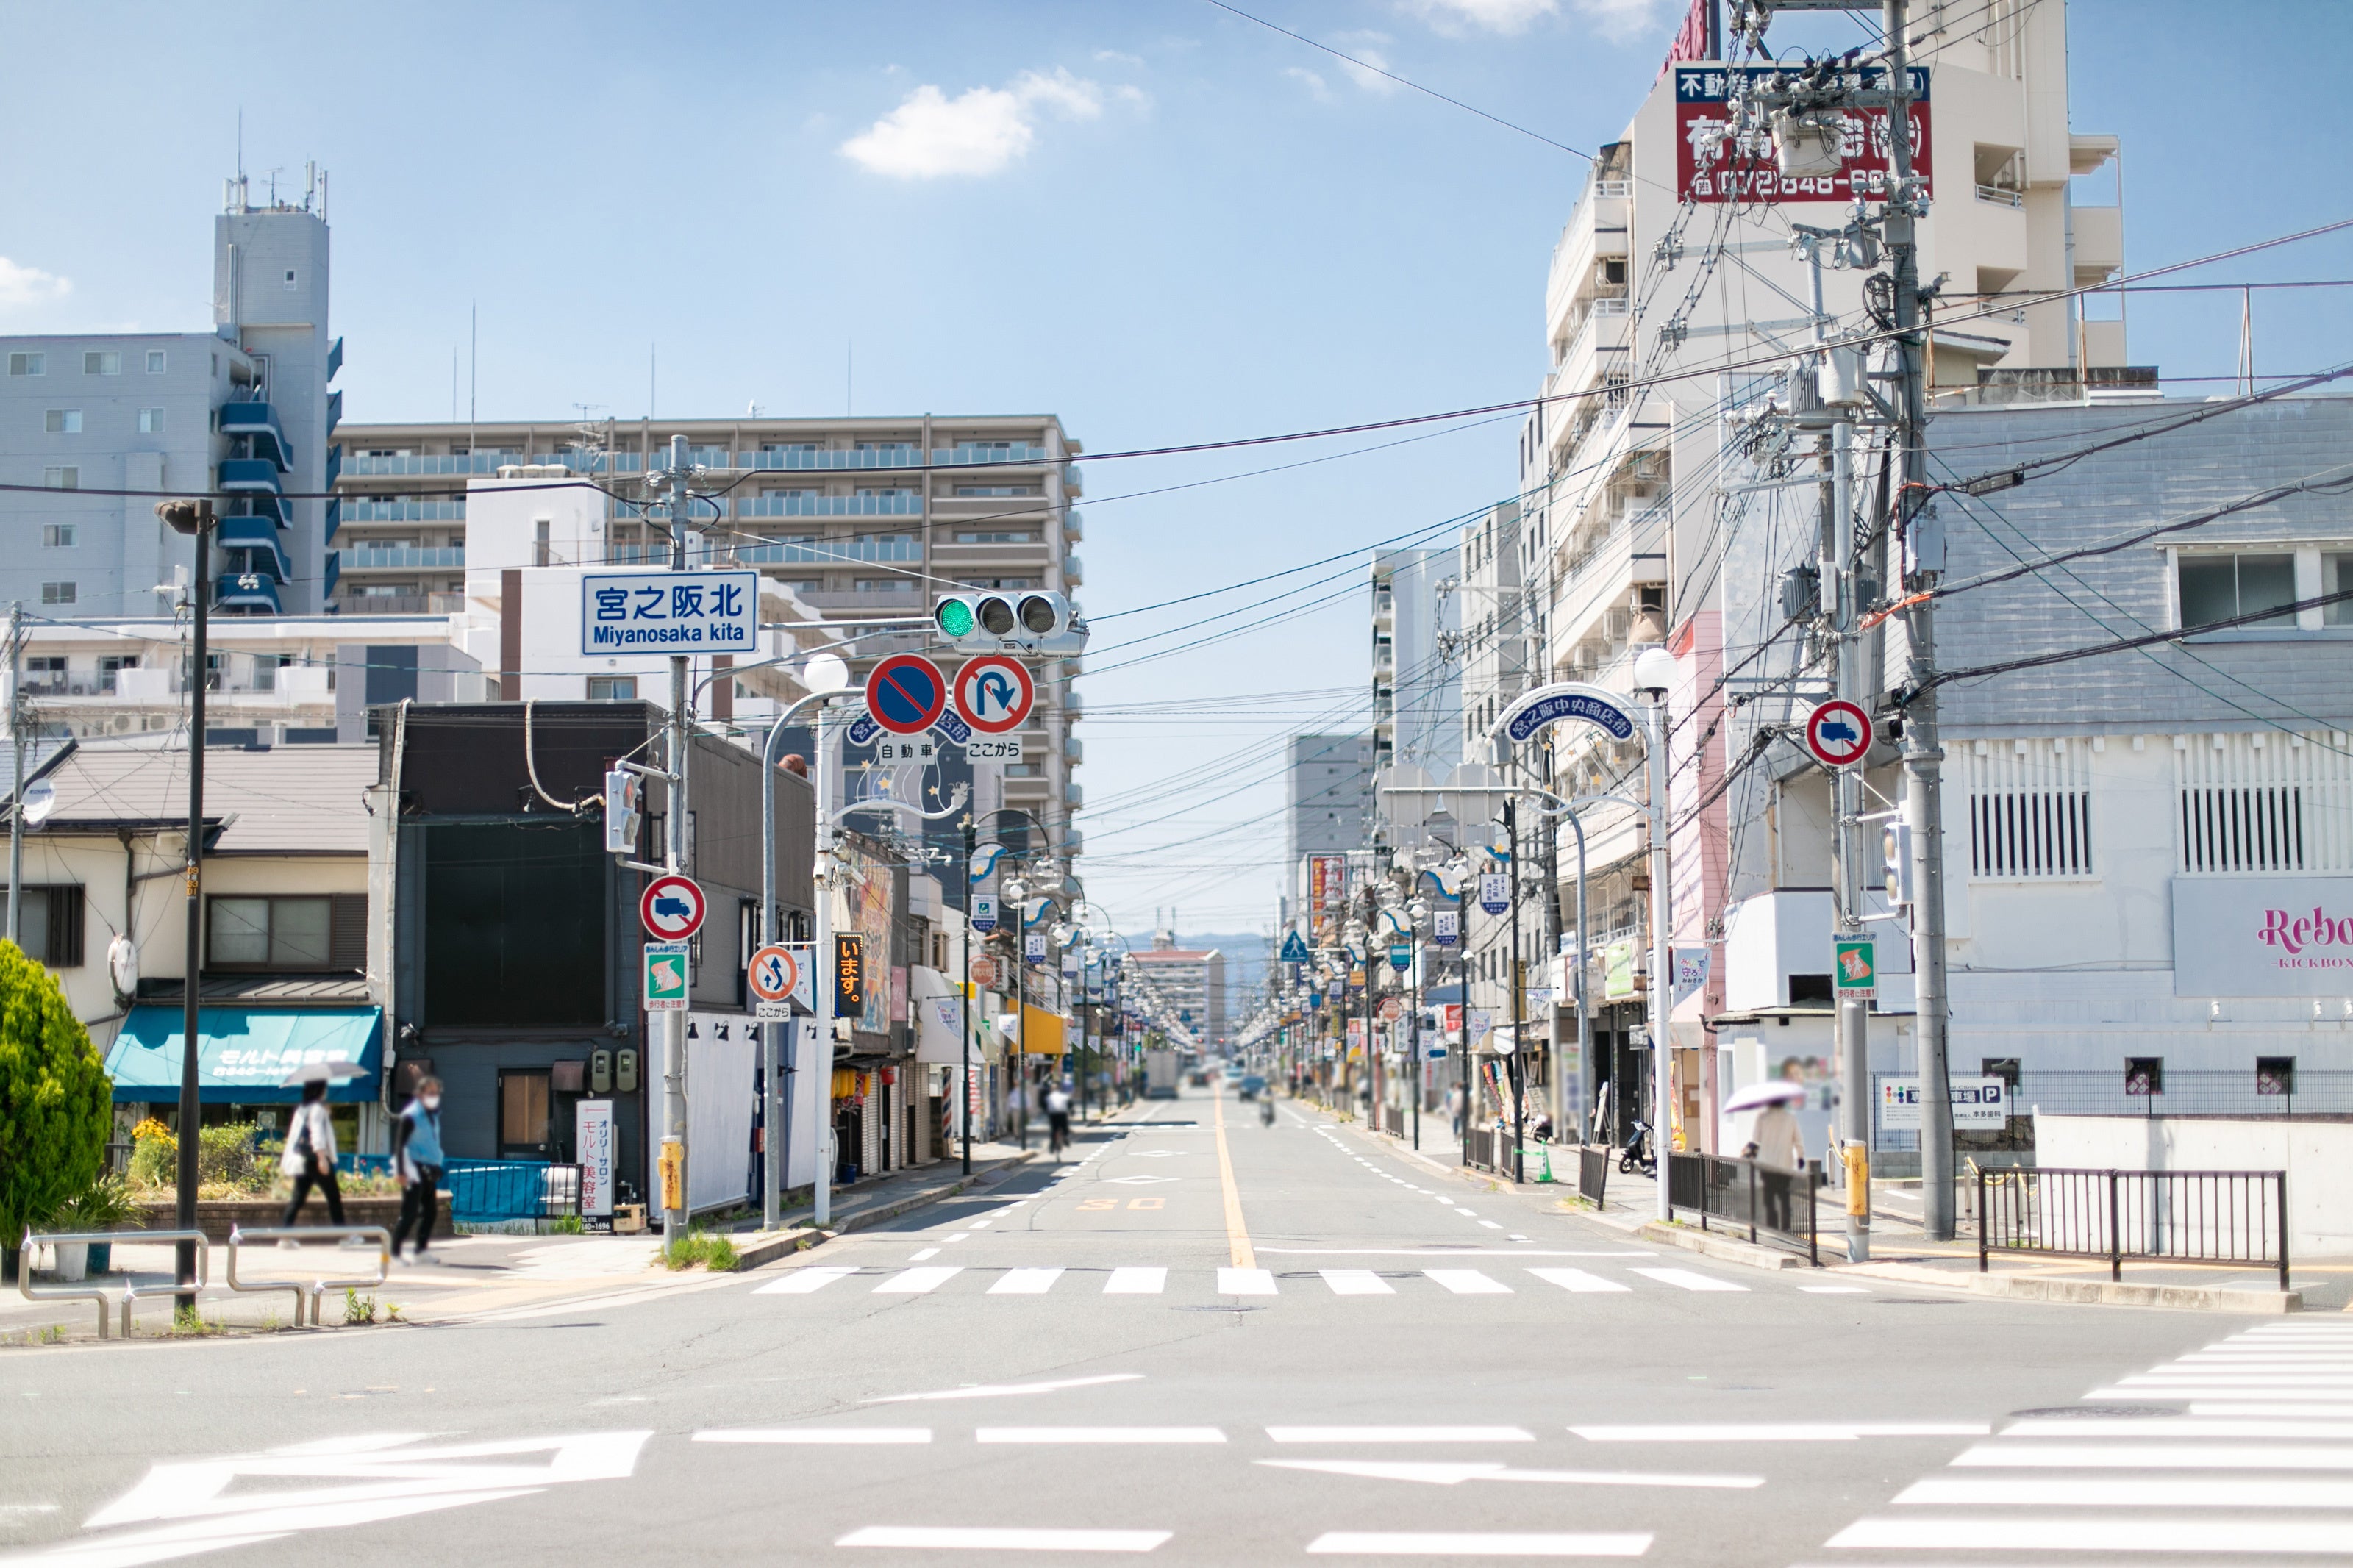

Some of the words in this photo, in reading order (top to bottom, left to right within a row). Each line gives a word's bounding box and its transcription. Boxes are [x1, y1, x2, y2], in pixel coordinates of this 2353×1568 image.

[594, 584, 743, 620] 宮之阪北
[593, 624, 703, 646] Miyanosaka
[710, 624, 744, 642] kita
[1513, 697, 1630, 737] 宮之阪中央商店街
[882, 743, 933, 759] 自動車
[968, 742, 1021, 758] ここから
[840, 941, 860, 1003] います。
[1838, 989, 1875, 998] 歩行者に注意!
[758, 1007, 789, 1017] ここから
[1986, 1088, 1998, 1102] P
[599, 1119, 608, 1186] オリリーサロン
[582, 1120, 596, 1209] モルト美容室
[1076, 1198, 1166, 1211] 30
